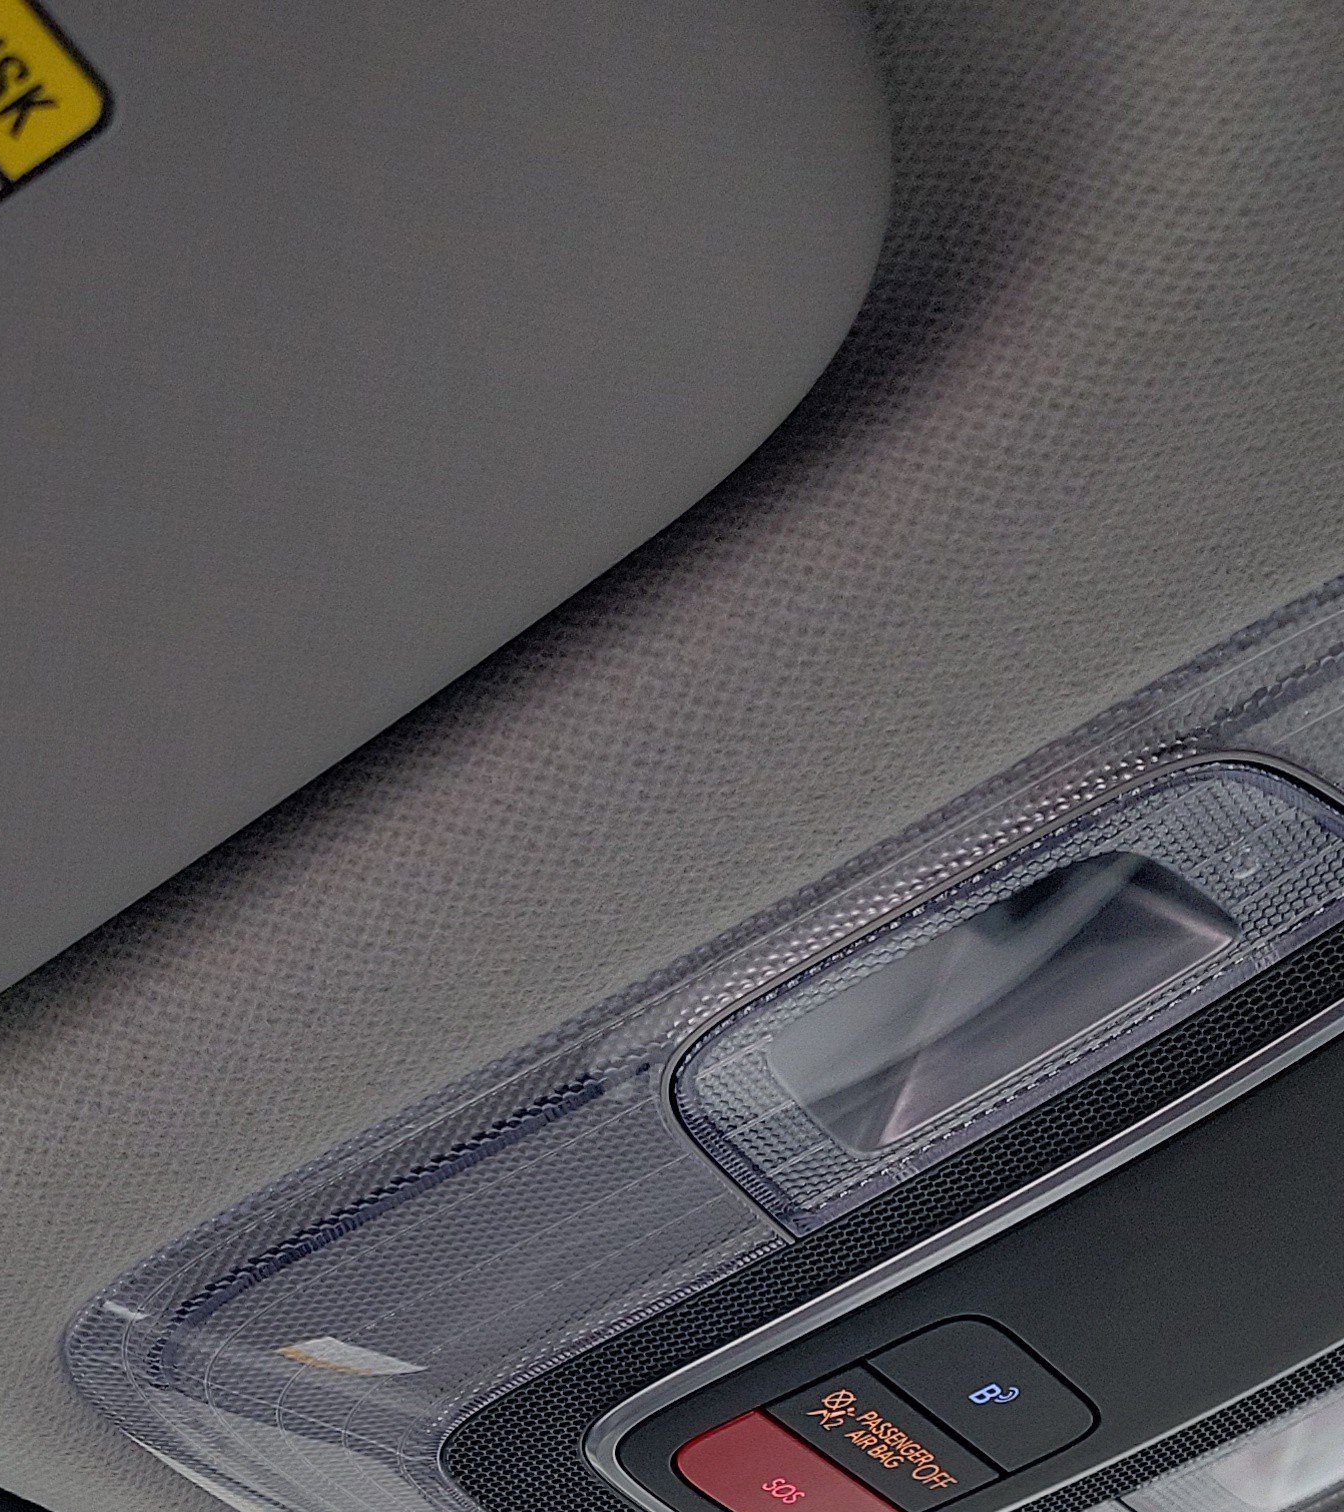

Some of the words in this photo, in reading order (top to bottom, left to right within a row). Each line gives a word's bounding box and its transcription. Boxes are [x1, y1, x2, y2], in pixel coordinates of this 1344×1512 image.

[844, 1430, 878, 1451] AIR
[867, 1444, 905, 1469] BAG
[856, 1410, 934, 1467] PASSENGER
[761, 1478, 805, 1504] SOS
[911, 1463, 958, 1490] OFF
